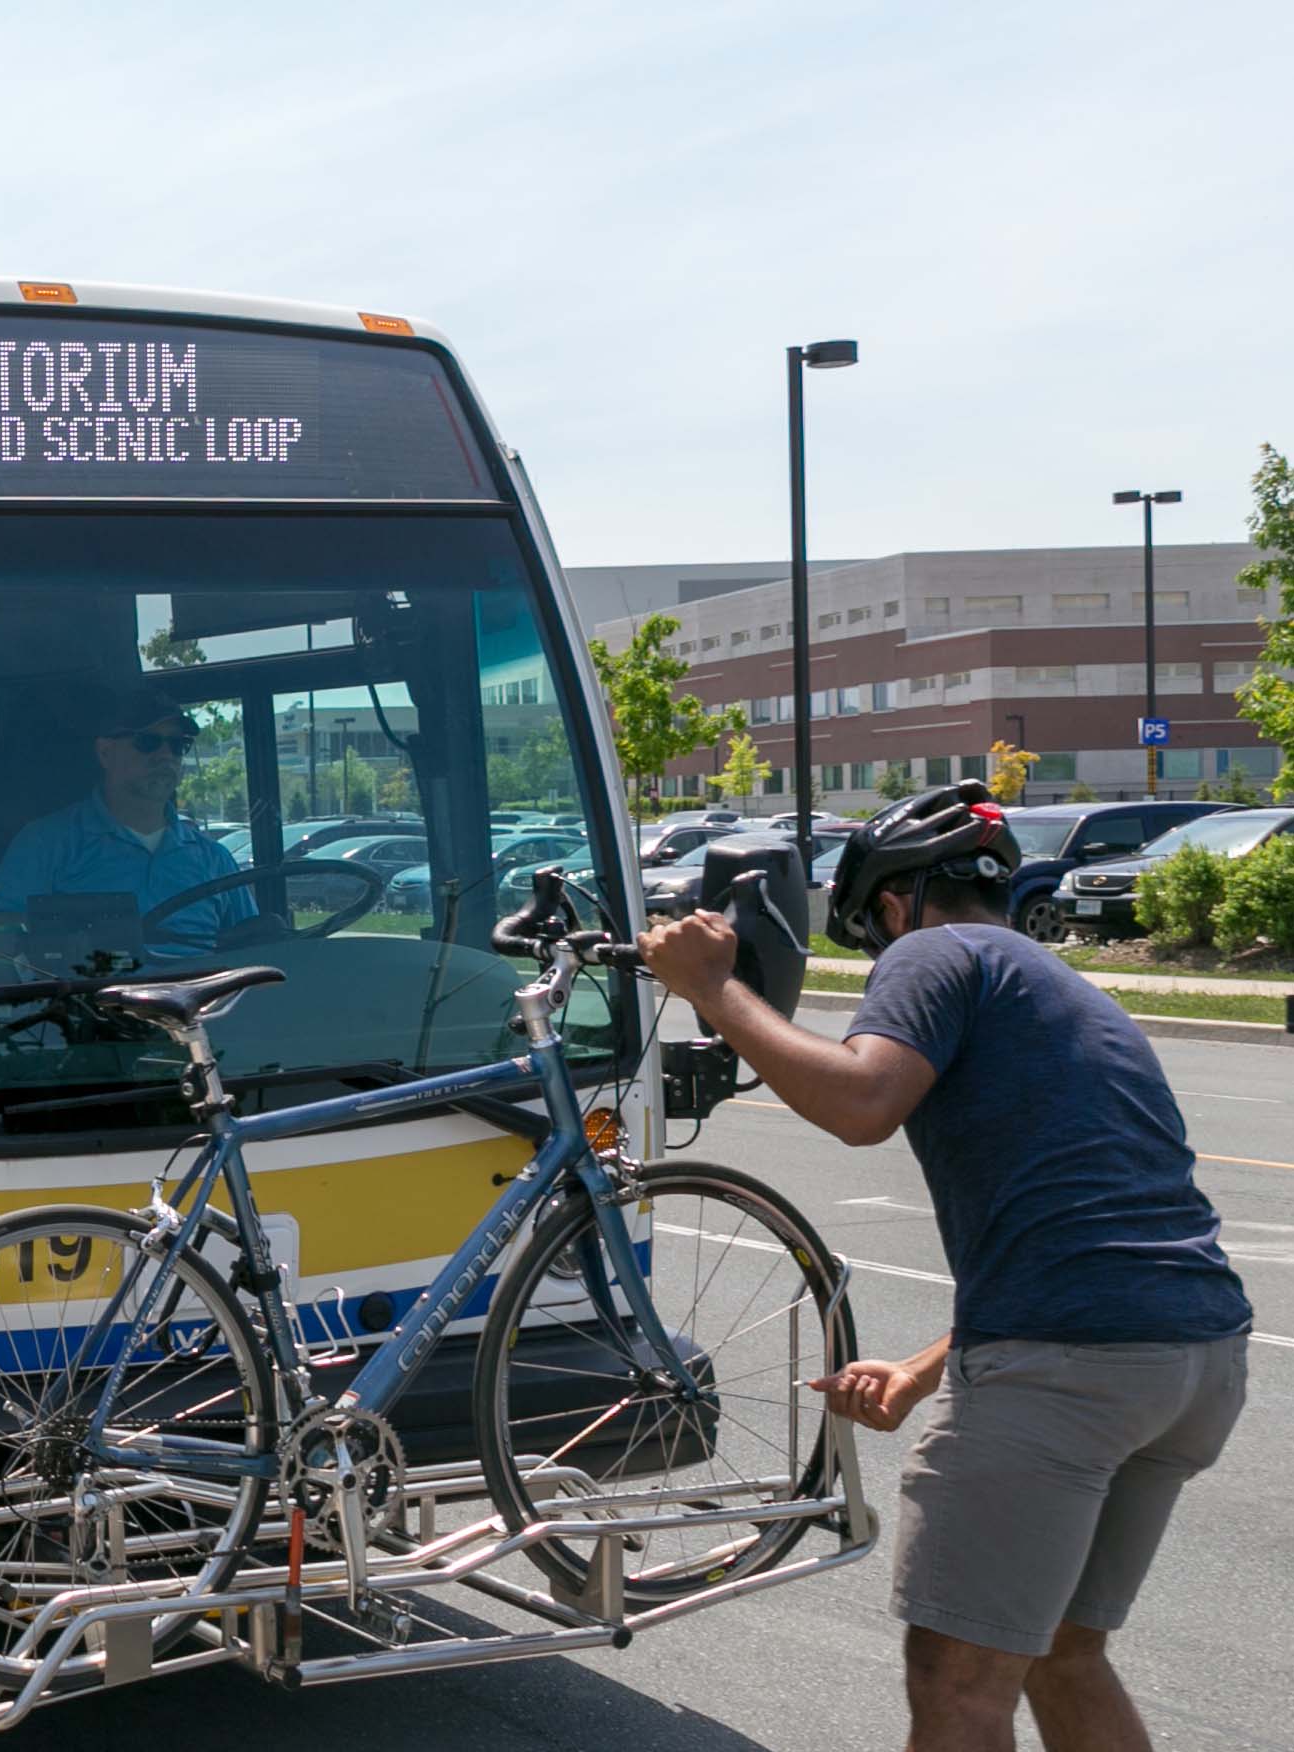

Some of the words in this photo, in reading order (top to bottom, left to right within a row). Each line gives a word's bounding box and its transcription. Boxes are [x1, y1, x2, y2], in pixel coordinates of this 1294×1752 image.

[43, 417, 190, 461] SCENIC
[206, 417, 302, 462] LOOP
[397, 1198, 527, 1372] cannondale
